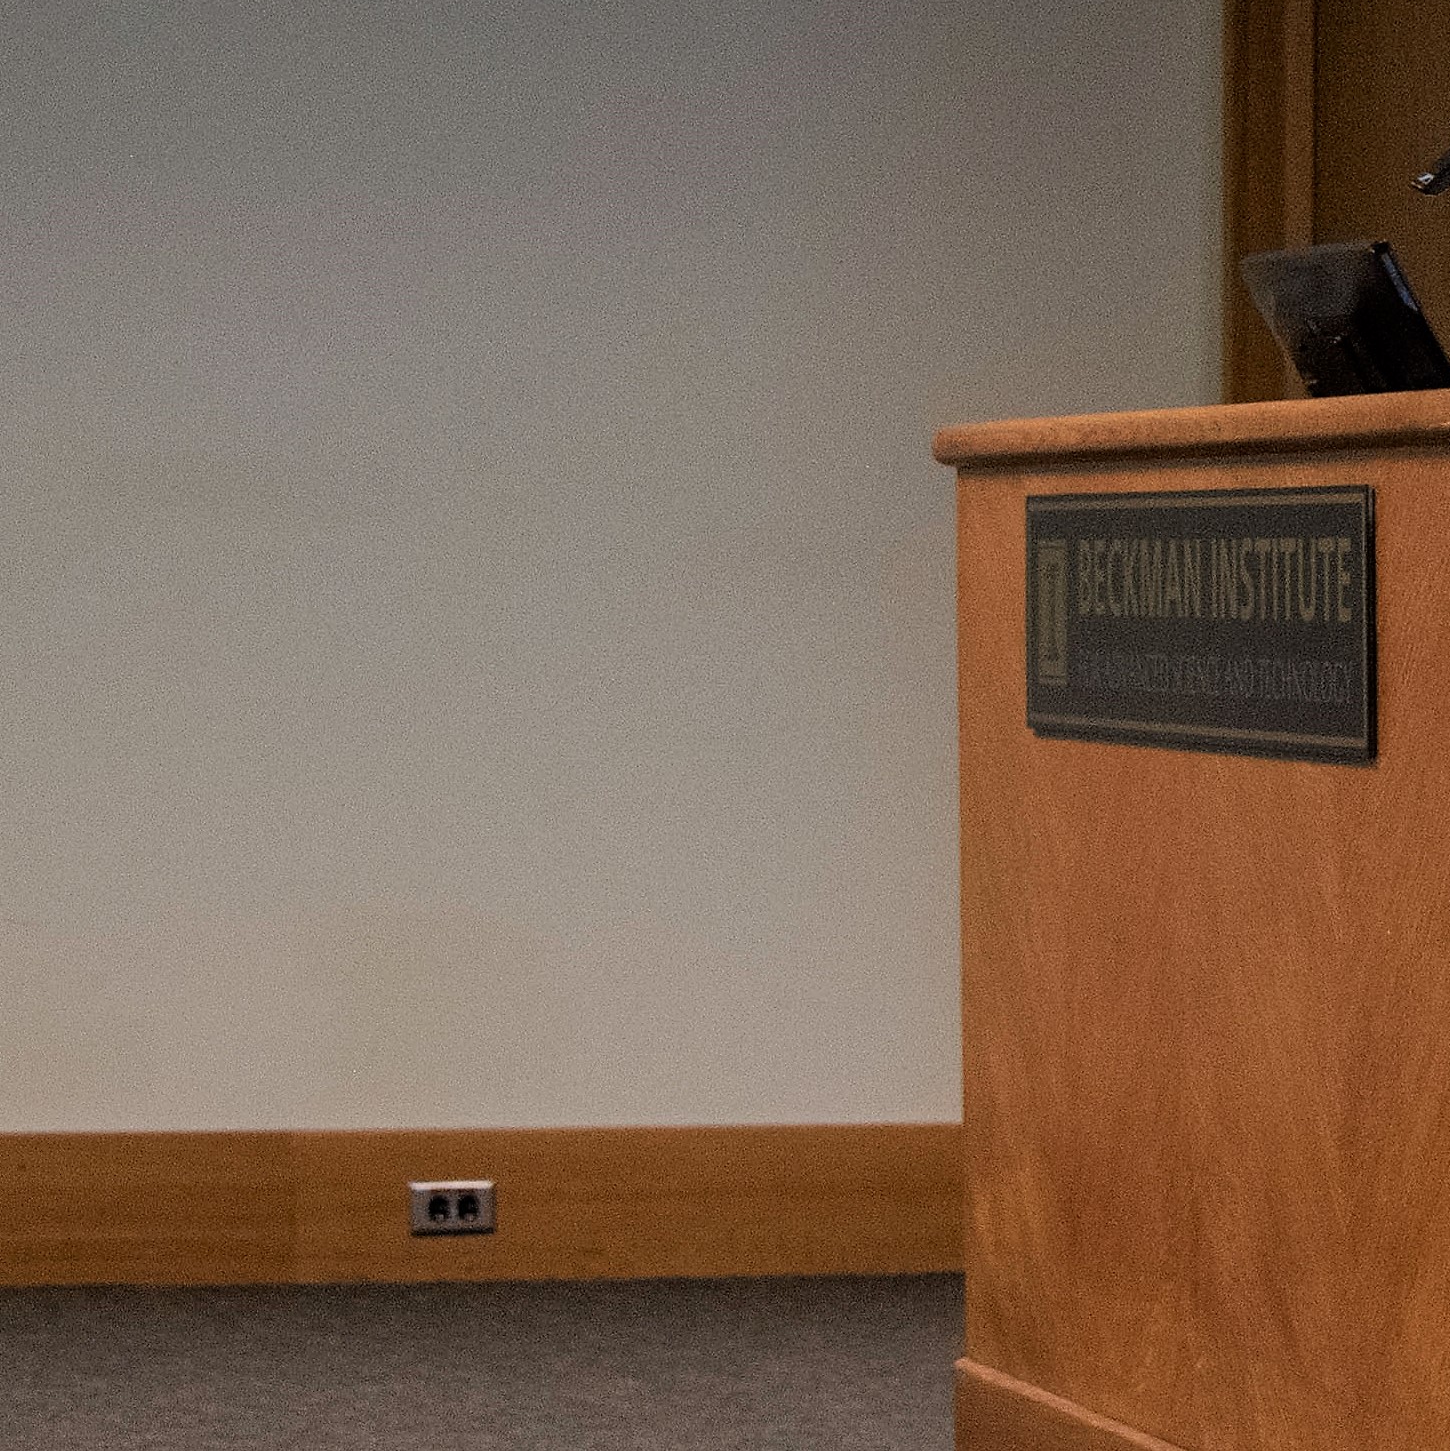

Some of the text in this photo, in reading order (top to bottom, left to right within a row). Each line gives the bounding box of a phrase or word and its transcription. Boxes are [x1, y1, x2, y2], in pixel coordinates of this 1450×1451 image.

[1079, 537, 1352, 623] BECKMAN INSTITUTE
[1224, 655, 1255, 699] AND
[1258, 657, 1354, 704] TECHNOLOGY
